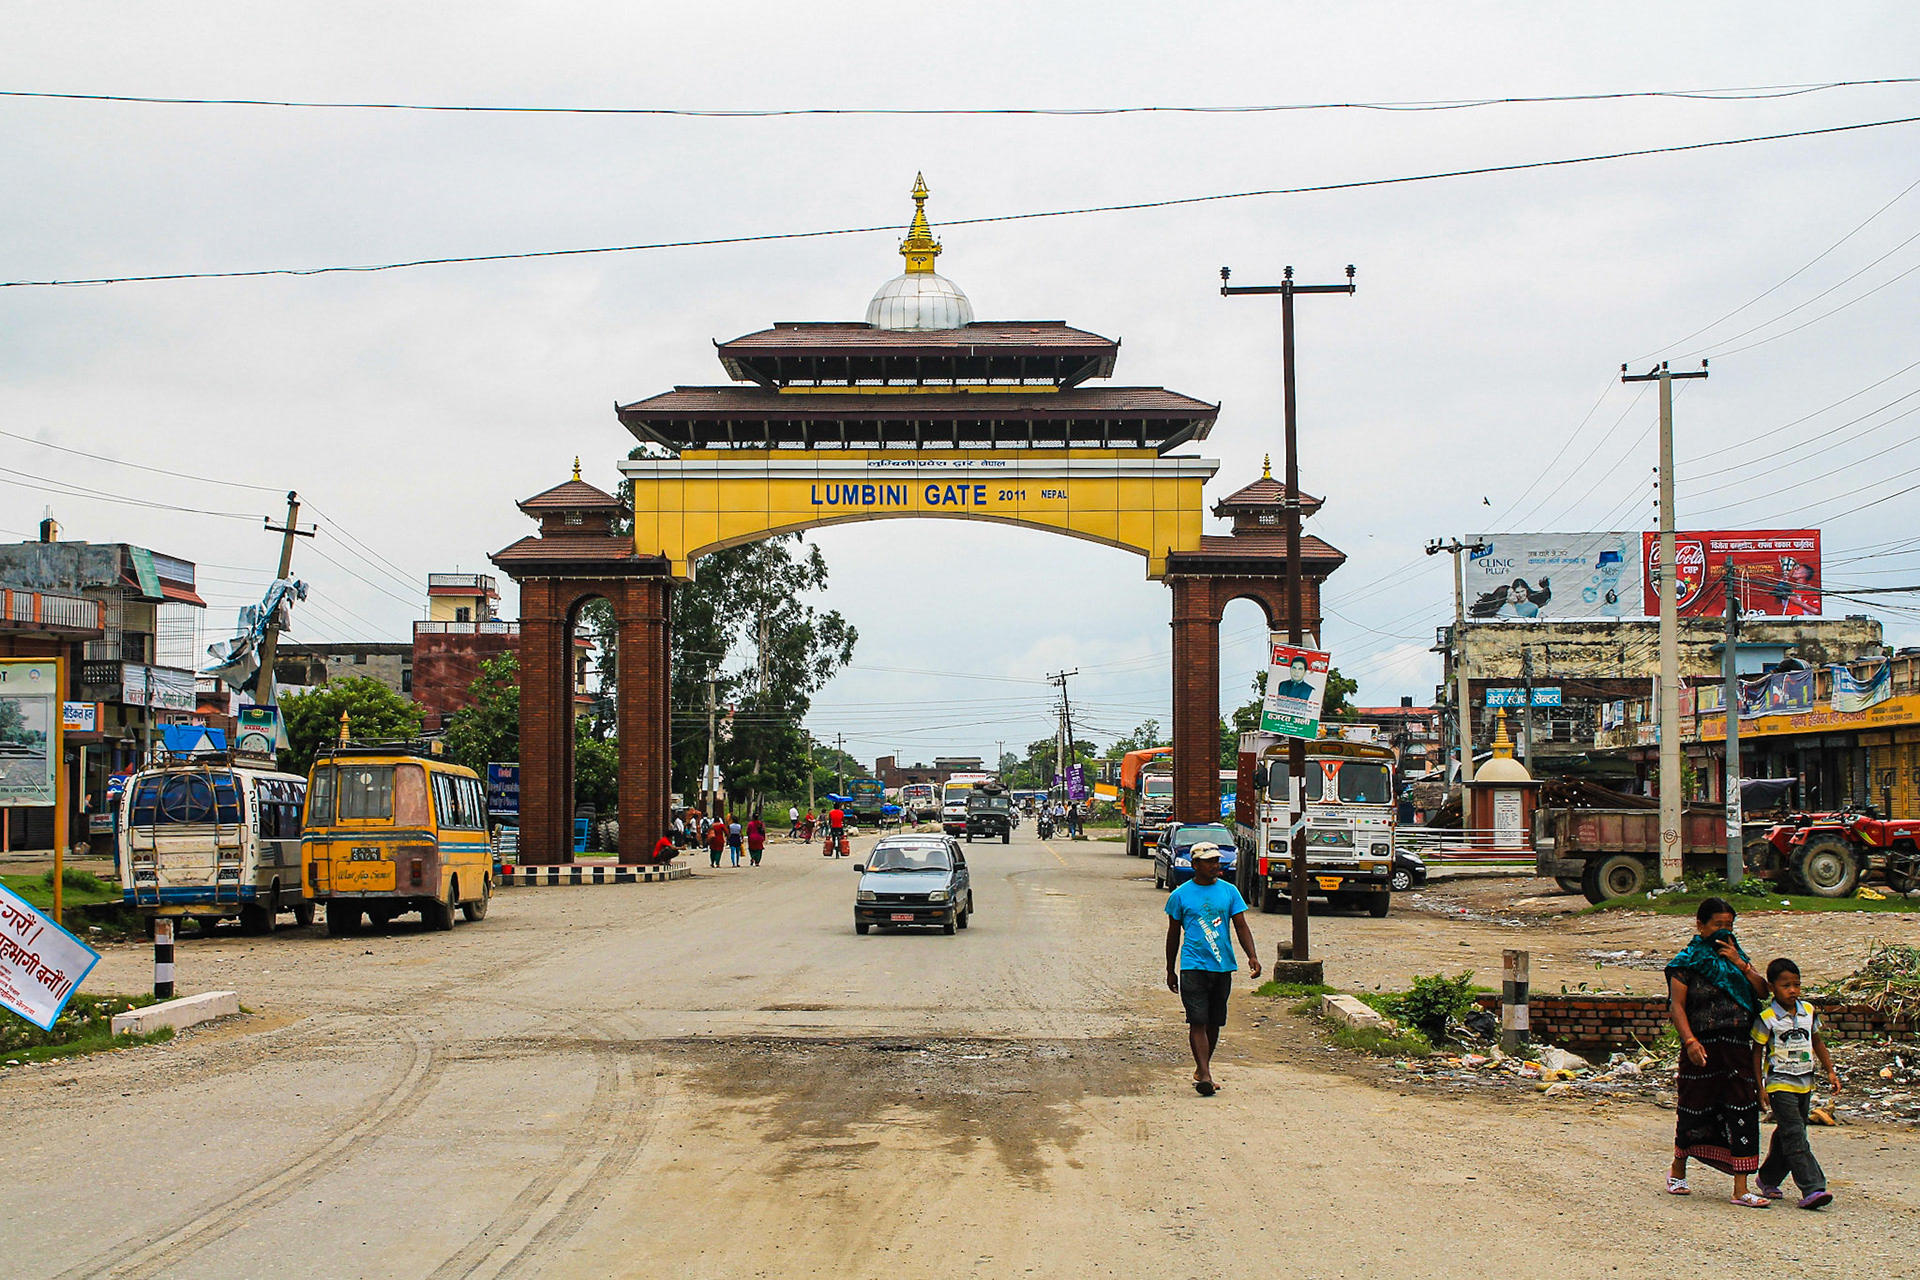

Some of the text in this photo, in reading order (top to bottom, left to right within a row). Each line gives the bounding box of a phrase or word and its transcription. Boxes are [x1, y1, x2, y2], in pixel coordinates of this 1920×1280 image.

[918, 459, 947, 467] प्रवेश
[980, 459, 1006, 467] नेपाल
[811, 484, 1068, 505] LUMBINI GATE 2011 NEPAL
[1478, 558, 1515, 568] CLINIC
[1683, 565, 1699, 574] CUP
[1533, 692, 1560, 705] सेन्टर
[250, 791, 259, 834] 2010
